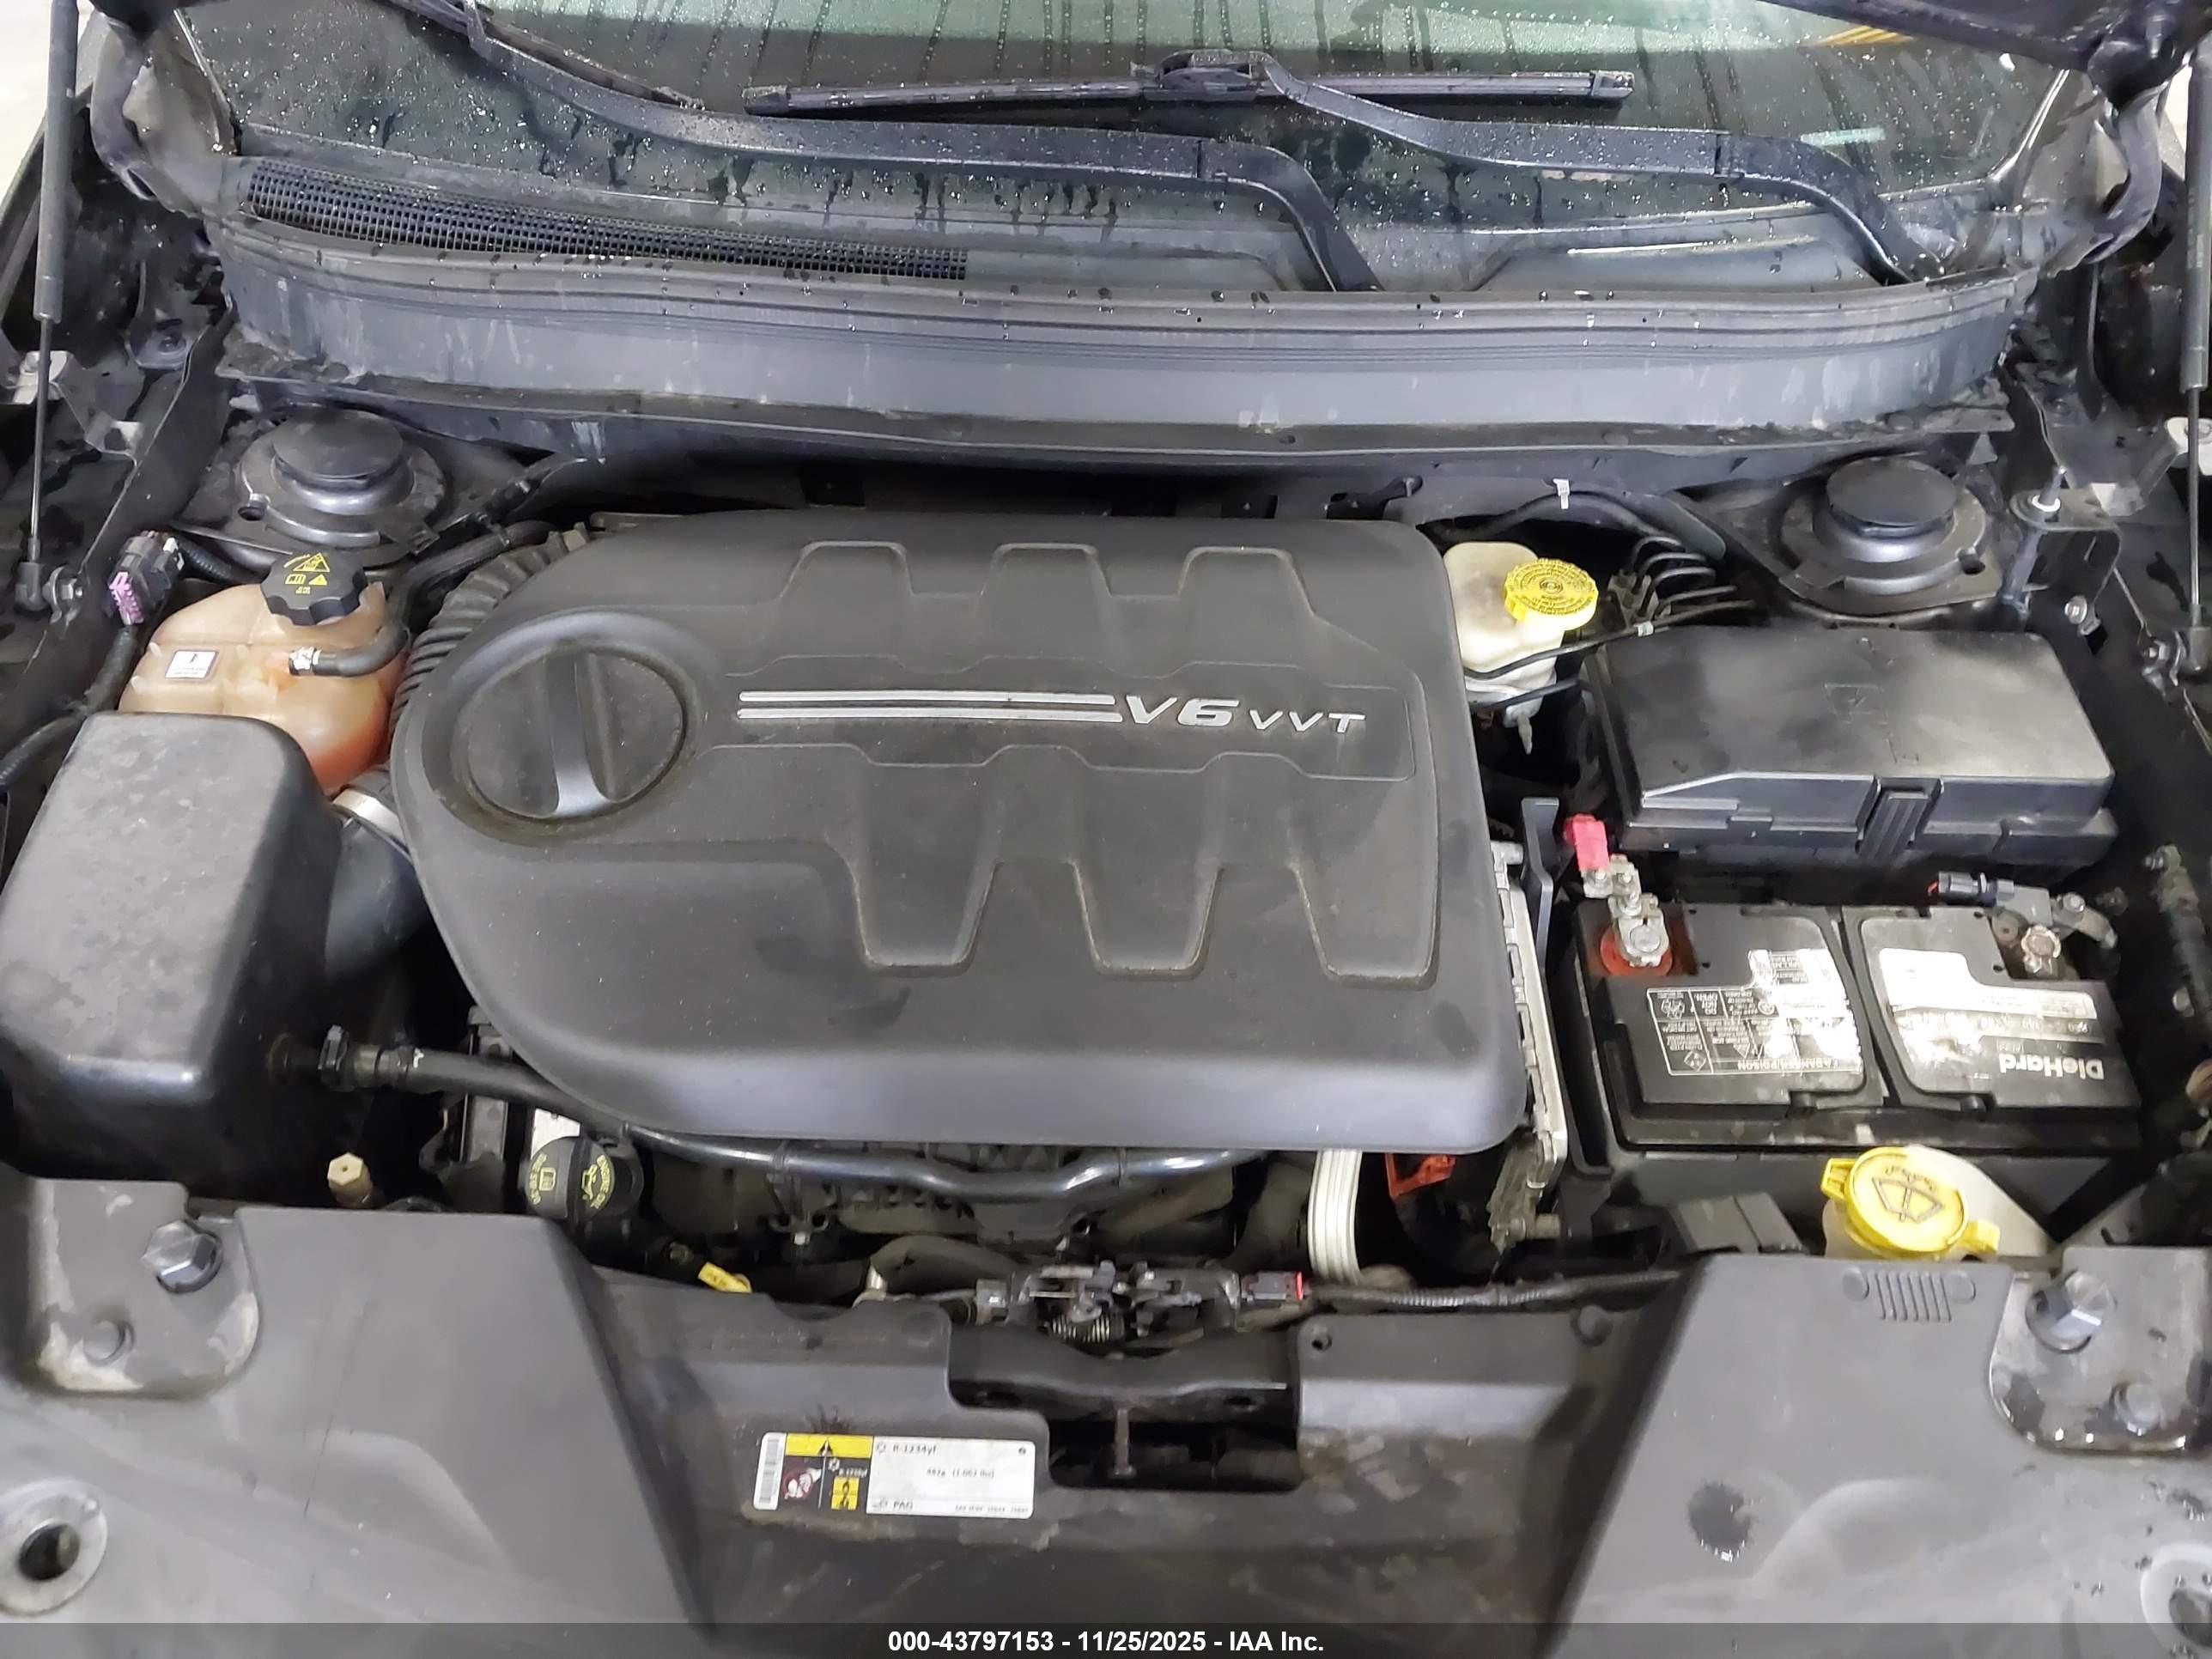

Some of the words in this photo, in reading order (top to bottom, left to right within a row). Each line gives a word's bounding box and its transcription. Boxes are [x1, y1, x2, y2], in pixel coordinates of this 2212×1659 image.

[1126, 694, 1240, 727] V6
[1249, 709, 1366, 733] VVT
[1998, 1053, 2105, 1080] DieHard
[597, 1155, 610, 1194] ENGINE
[590, 1193, 605, 1210] OIL
